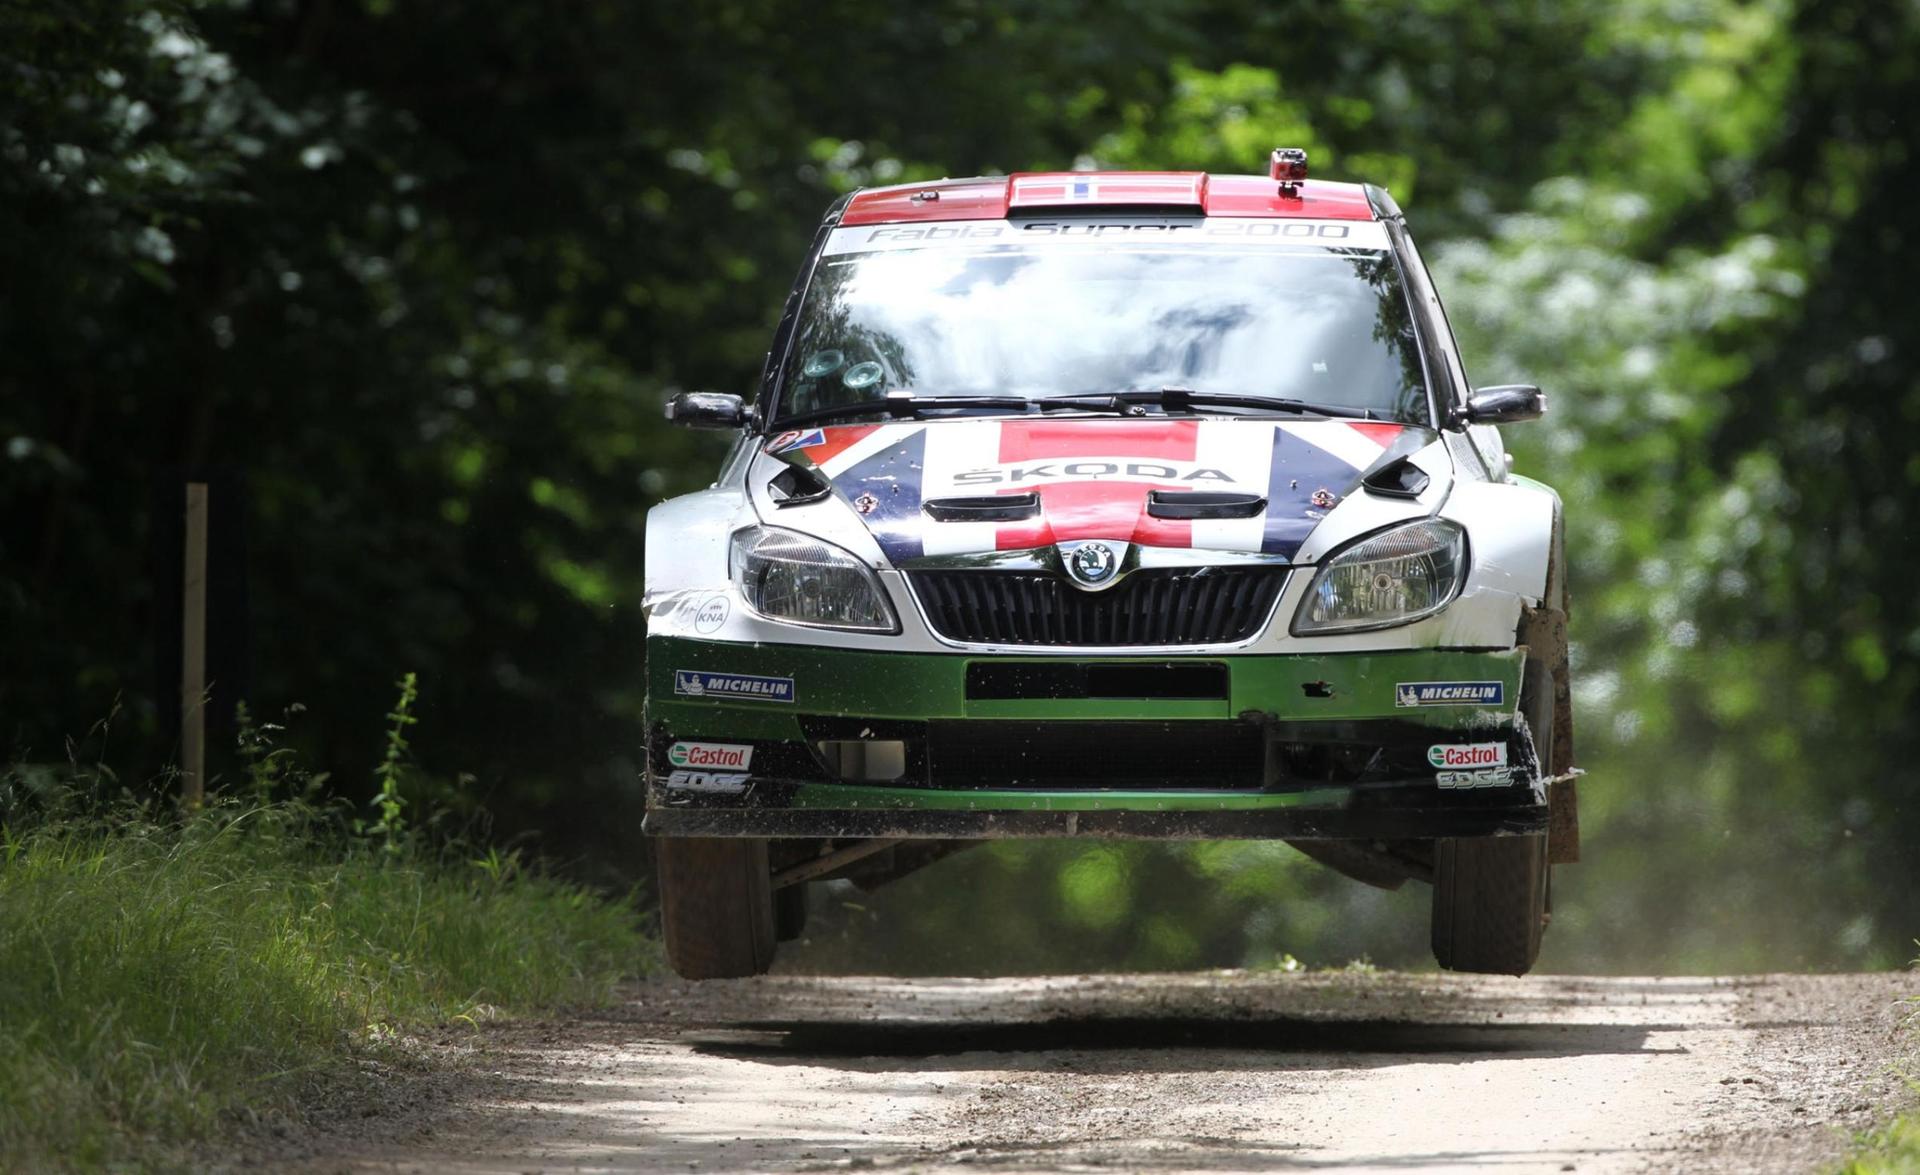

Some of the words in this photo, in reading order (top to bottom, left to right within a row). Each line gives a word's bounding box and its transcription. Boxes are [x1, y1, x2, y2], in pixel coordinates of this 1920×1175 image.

[866, 225, 1004, 243] Fabia
[1020, 222, 1194, 238] Super
[1207, 223, 1350, 239] 2000
[952, 463, 1237, 486] ŠKODA
[698, 613, 724, 623] KNA
[707, 678, 788, 695] MICHELIN
[1420, 686, 1497, 700] MICHELIN
[688, 746, 745, 766] Castrol
[1445, 746, 1499, 765] Castrol
[666, 770, 752, 794] EDGE
[1436, 767, 1514, 789] EDGE
